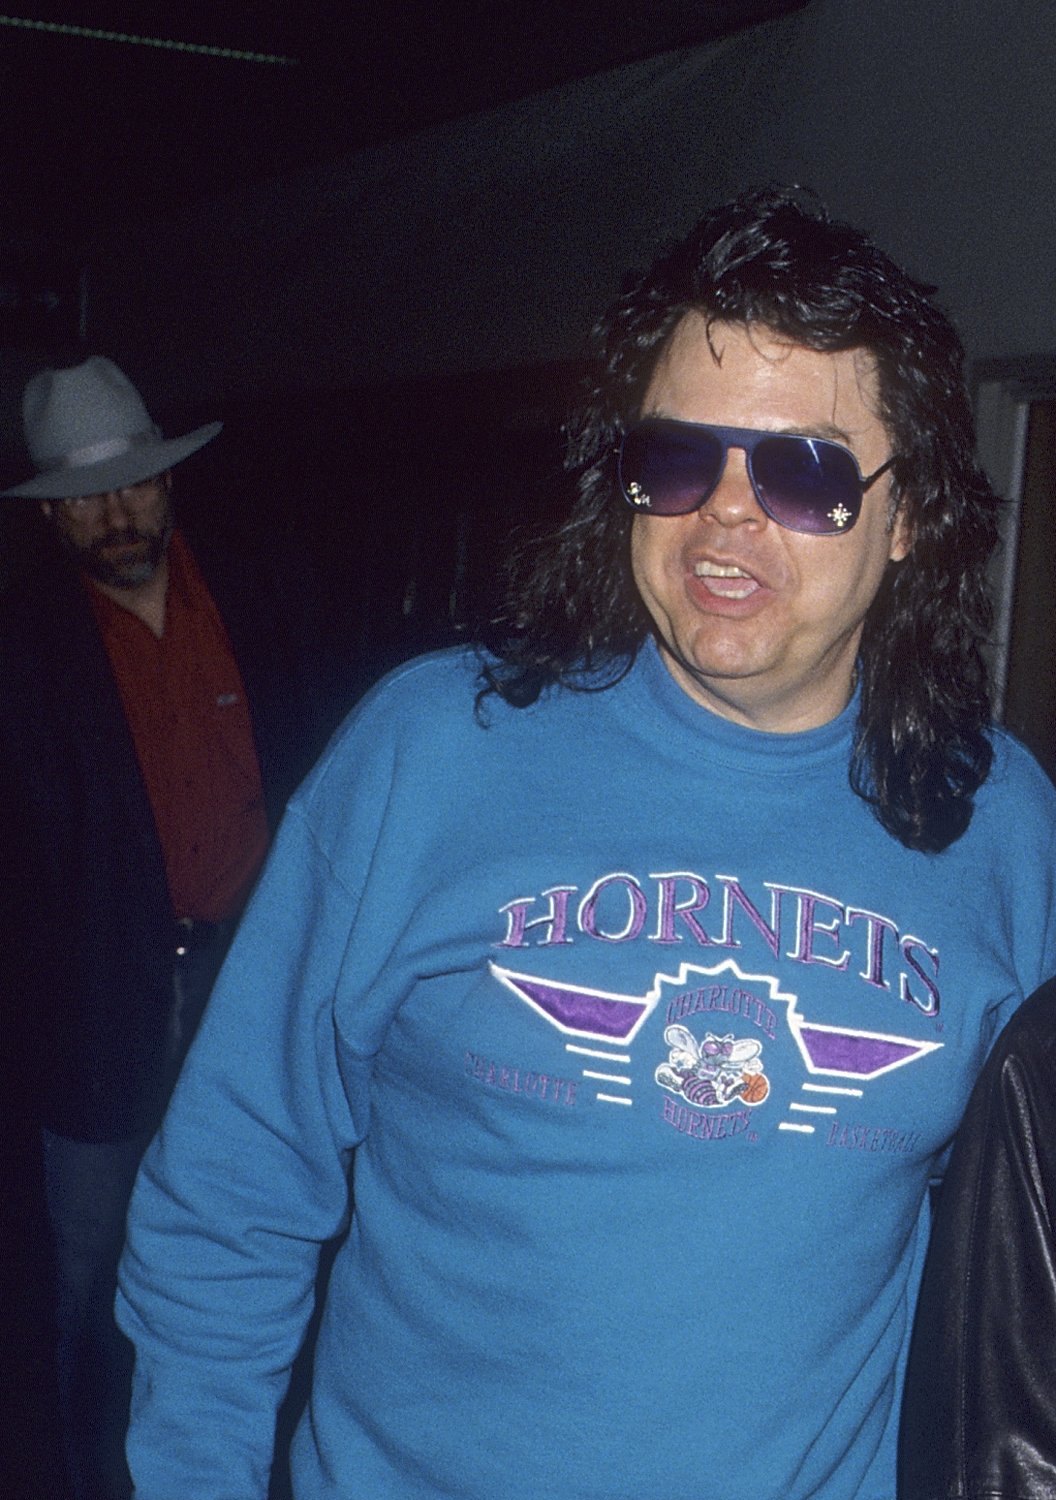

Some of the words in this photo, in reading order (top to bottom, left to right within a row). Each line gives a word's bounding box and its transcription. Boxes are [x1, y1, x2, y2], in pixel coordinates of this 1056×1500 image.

[490, 872, 941, 1017] HORNETS
[666, 983, 778, 1040] CHARLOTTE
[463, 1050, 580, 1105] CHARLOTTE
[660, 1094, 752, 1140] HORNETS
[825, 1119, 923, 1153] BASKETBALL
